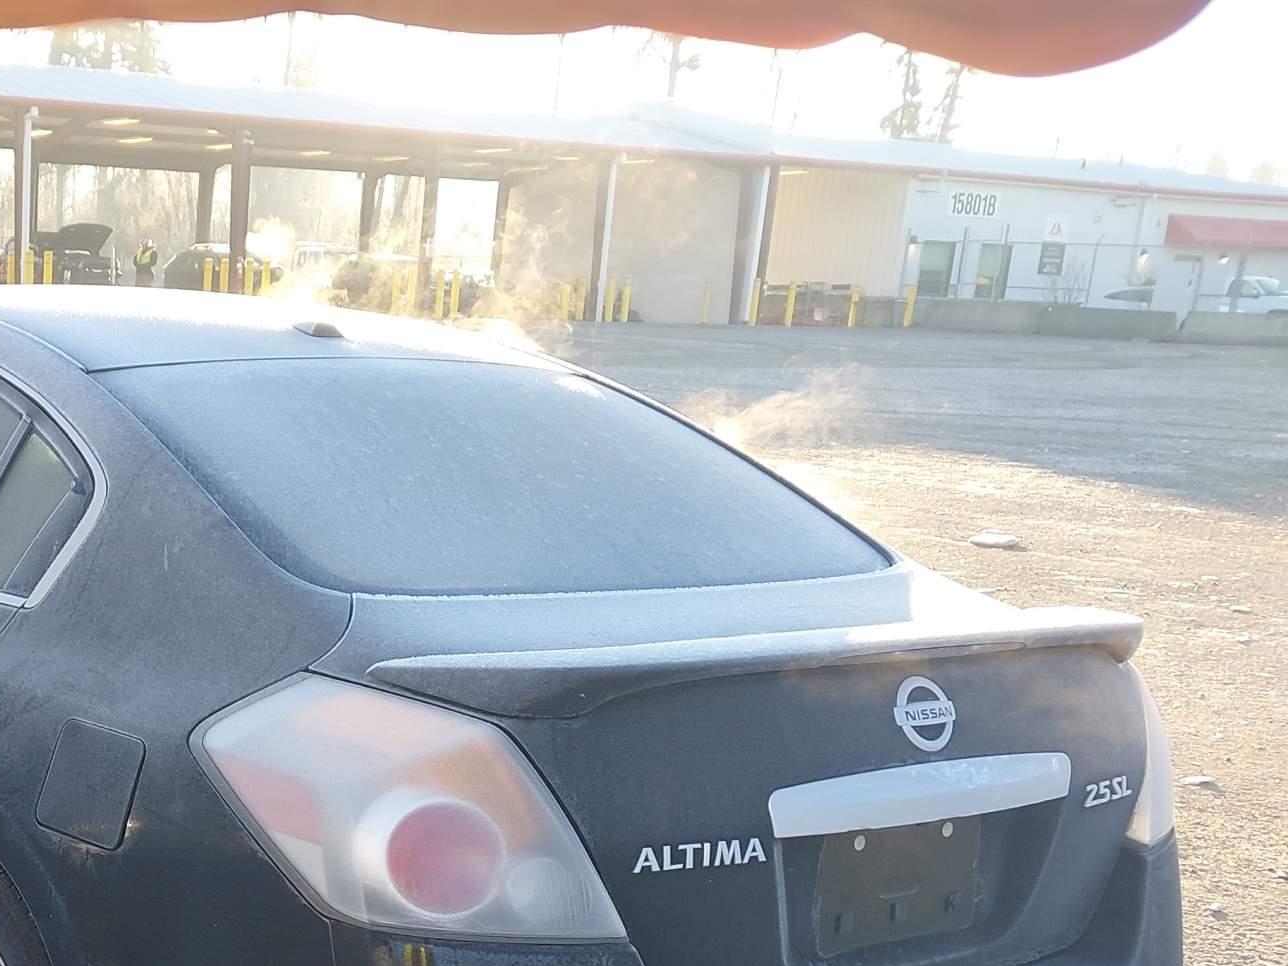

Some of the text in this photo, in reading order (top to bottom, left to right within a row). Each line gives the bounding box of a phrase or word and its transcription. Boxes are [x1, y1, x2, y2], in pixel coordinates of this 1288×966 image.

[951, 191, 998, 217] 15801B
[903, 704, 953, 722] NISSAN
[632, 837, 768, 874] ALTIMA
